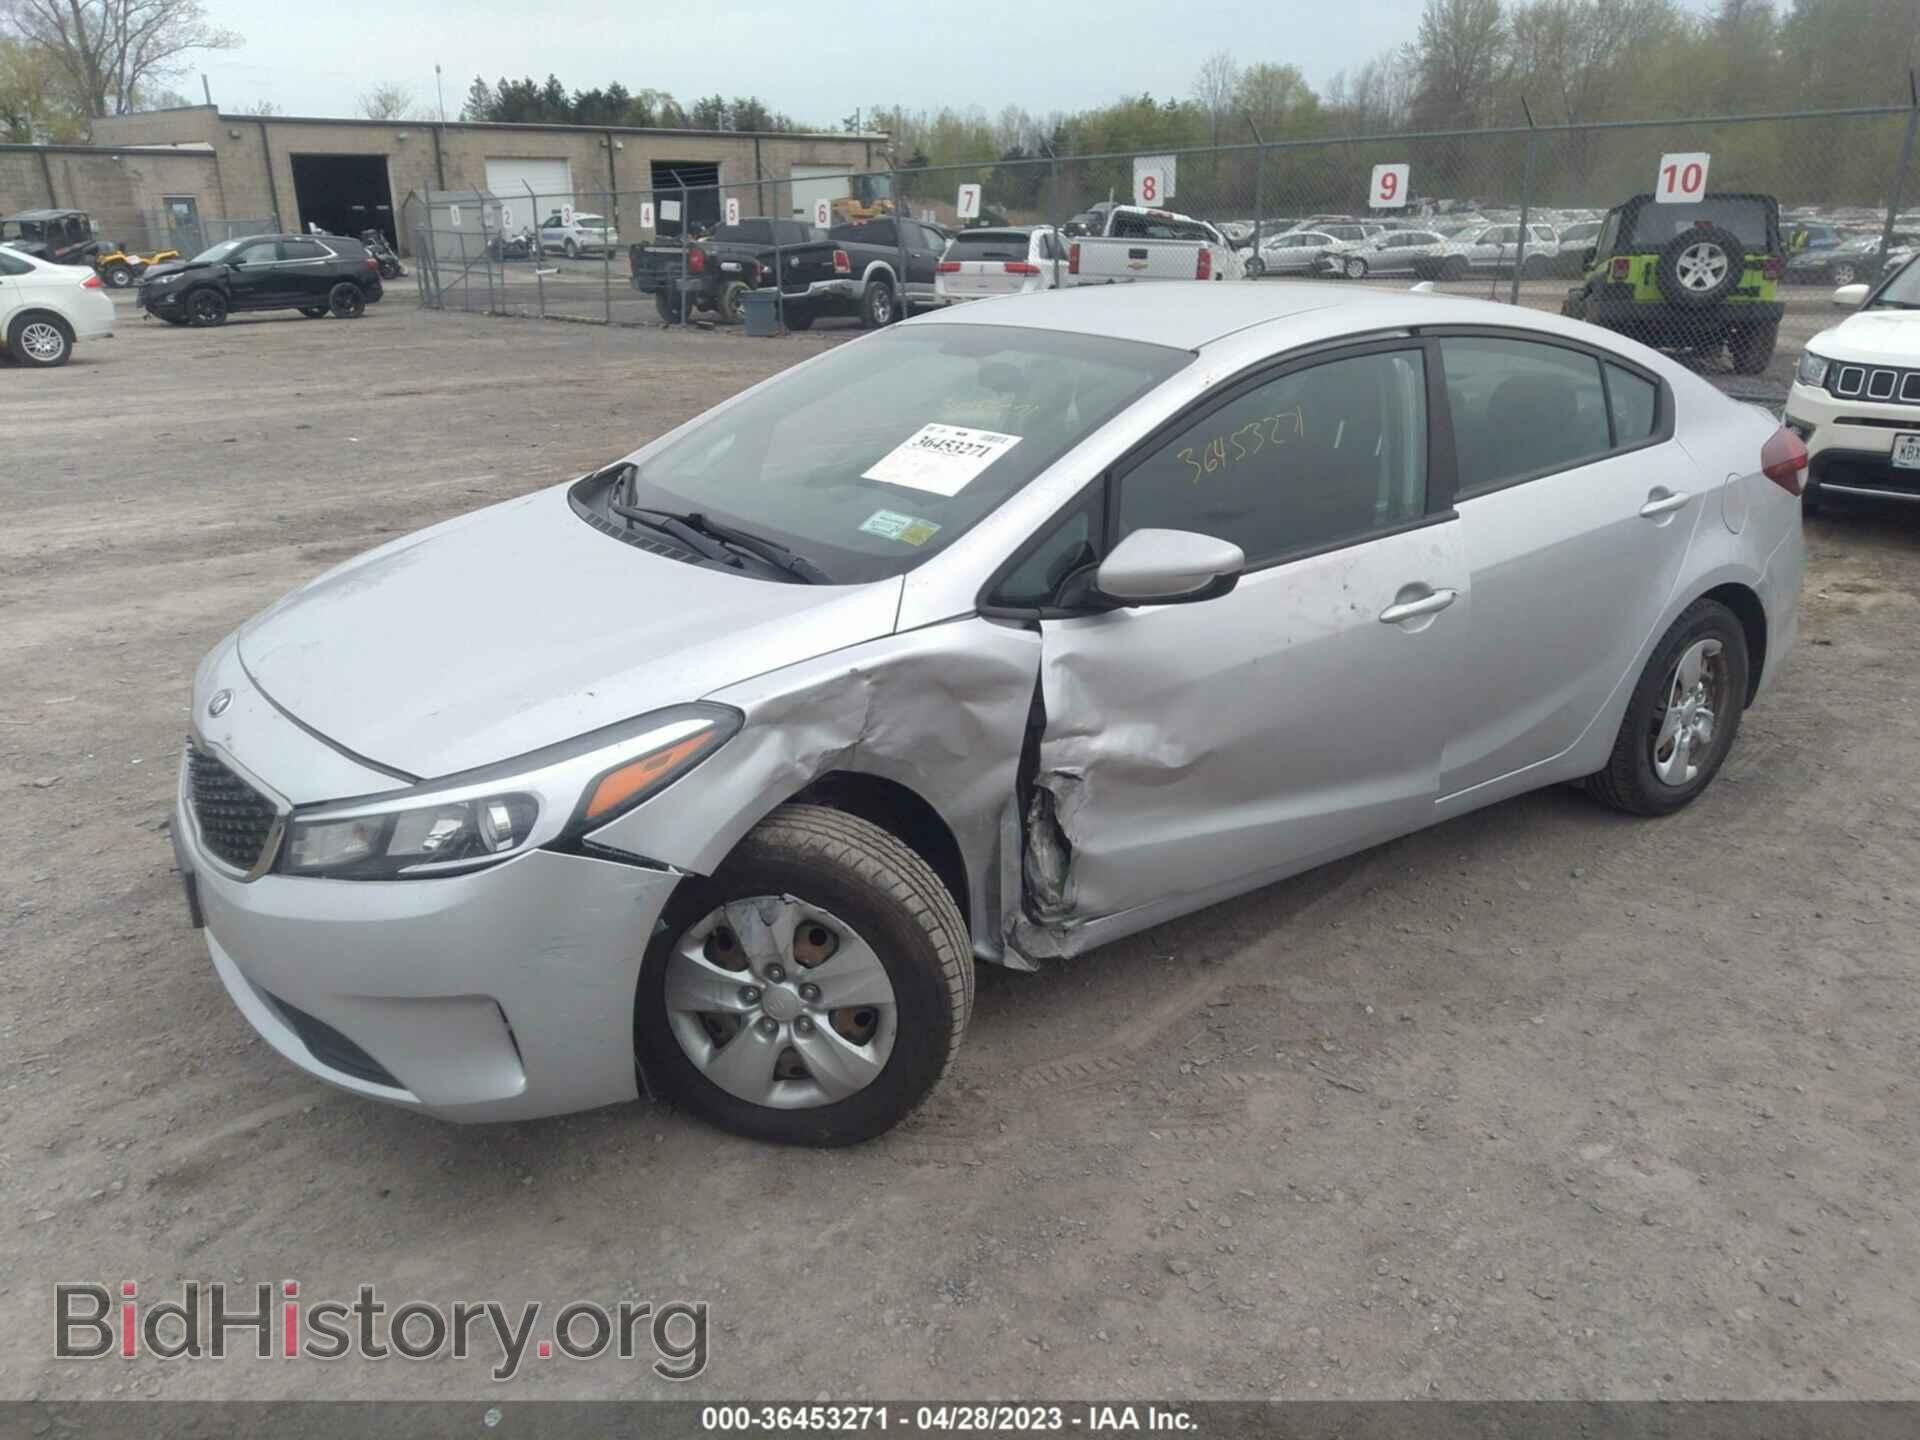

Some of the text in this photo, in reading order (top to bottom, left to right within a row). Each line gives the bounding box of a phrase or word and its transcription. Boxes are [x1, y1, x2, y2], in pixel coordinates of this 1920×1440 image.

[1142, 175, 1156, 201] 8
[1379, 171, 1398, 200] 9
[1662, 162, 1703, 194] 10
[728, 201, 736, 222] 5
[963, 190, 974, 213] 7
[504, 209, 511, 225] 2
[564, 207, 570, 224] 3
[643, 207, 650, 224] 4
[818, 203, 826, 223] 6
[911, 435, 992, 458] 36453271
